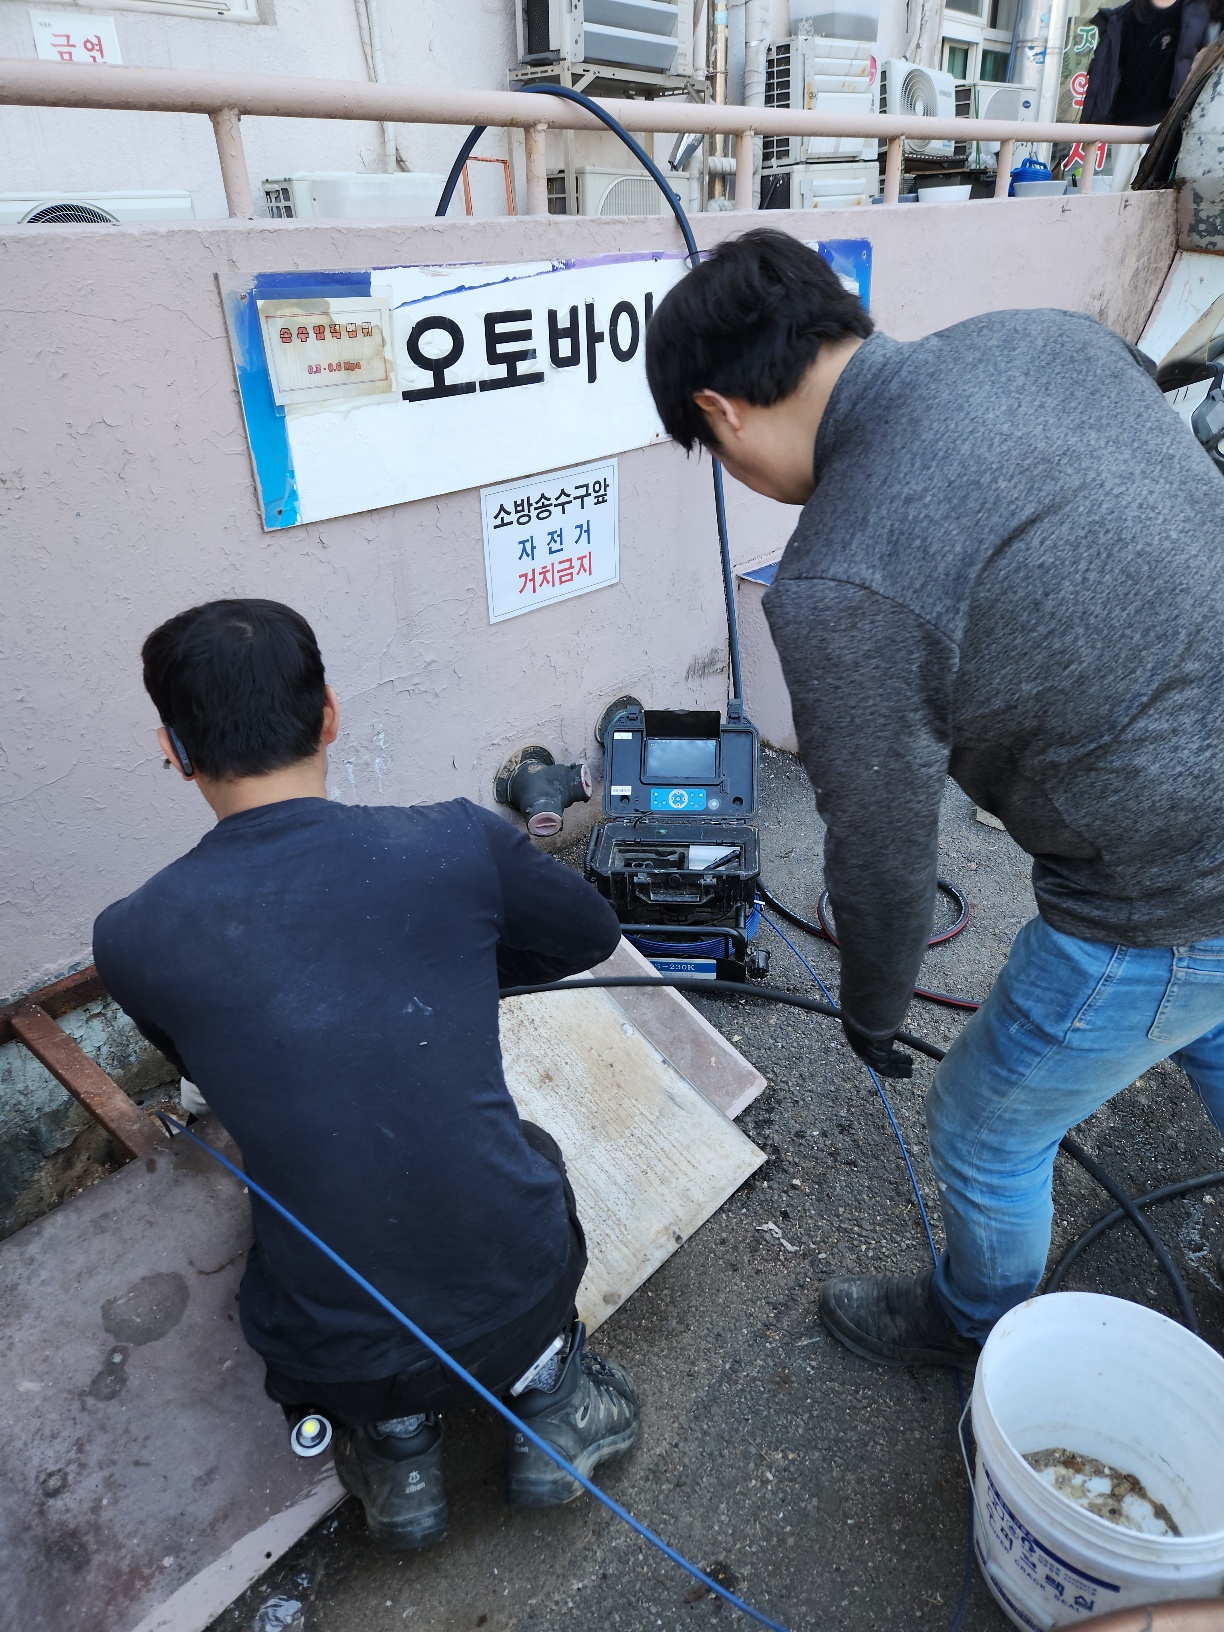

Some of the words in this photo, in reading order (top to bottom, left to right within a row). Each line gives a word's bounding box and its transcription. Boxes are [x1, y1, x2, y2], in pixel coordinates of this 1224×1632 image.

[493, 478, 610, 529] 소방송수구앞
[518, 551, 593, 594] 거치금지
[1014, 1559, 1047, 1592] CRACK
